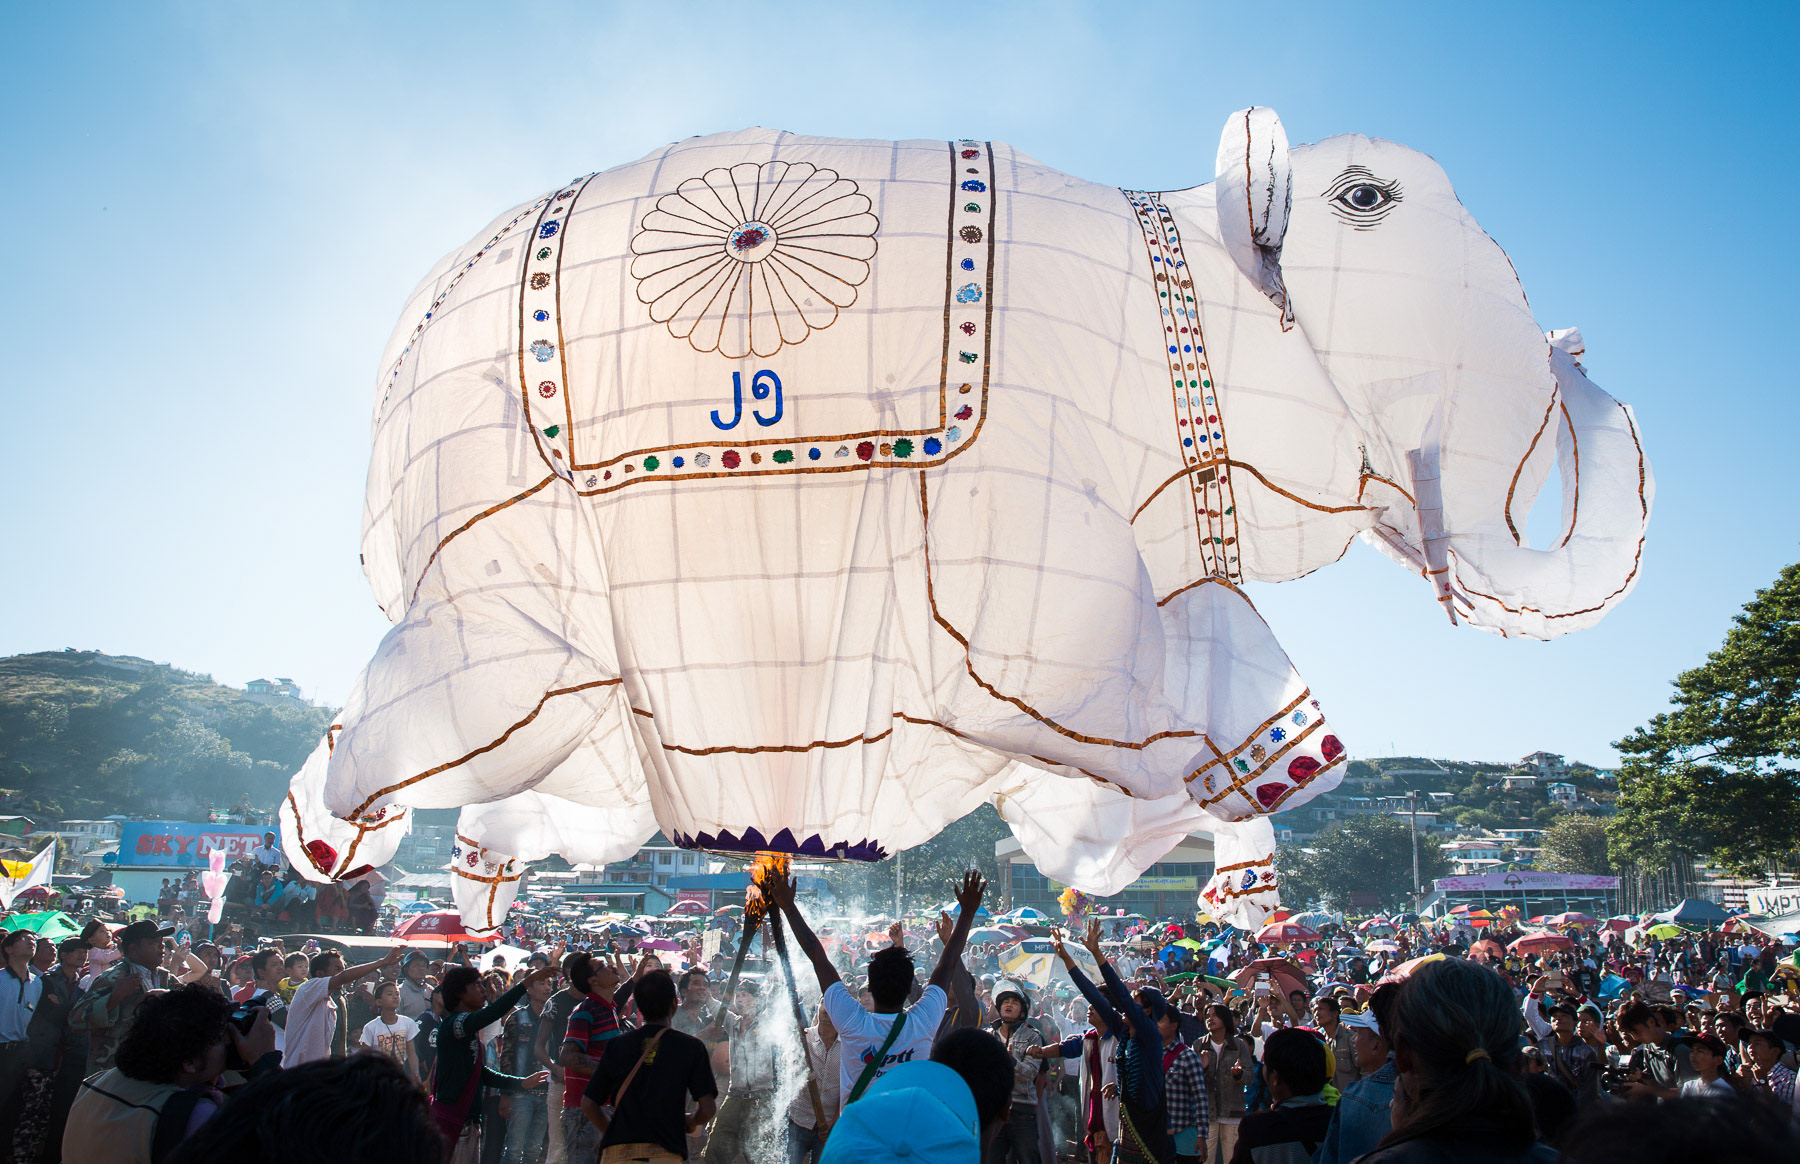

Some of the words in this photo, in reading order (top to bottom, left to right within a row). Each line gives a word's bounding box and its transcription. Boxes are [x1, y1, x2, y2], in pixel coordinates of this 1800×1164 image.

[136, 834, 195, 856] SKY
[200, 835, 260, 856] NET
[1523, 875, 1549, 883] CHERRY
[1764, 894, 1800, 916] MPT
[1077, 949, 1091, 959] MPT
[879, 1047, 915, 1068] ptt
